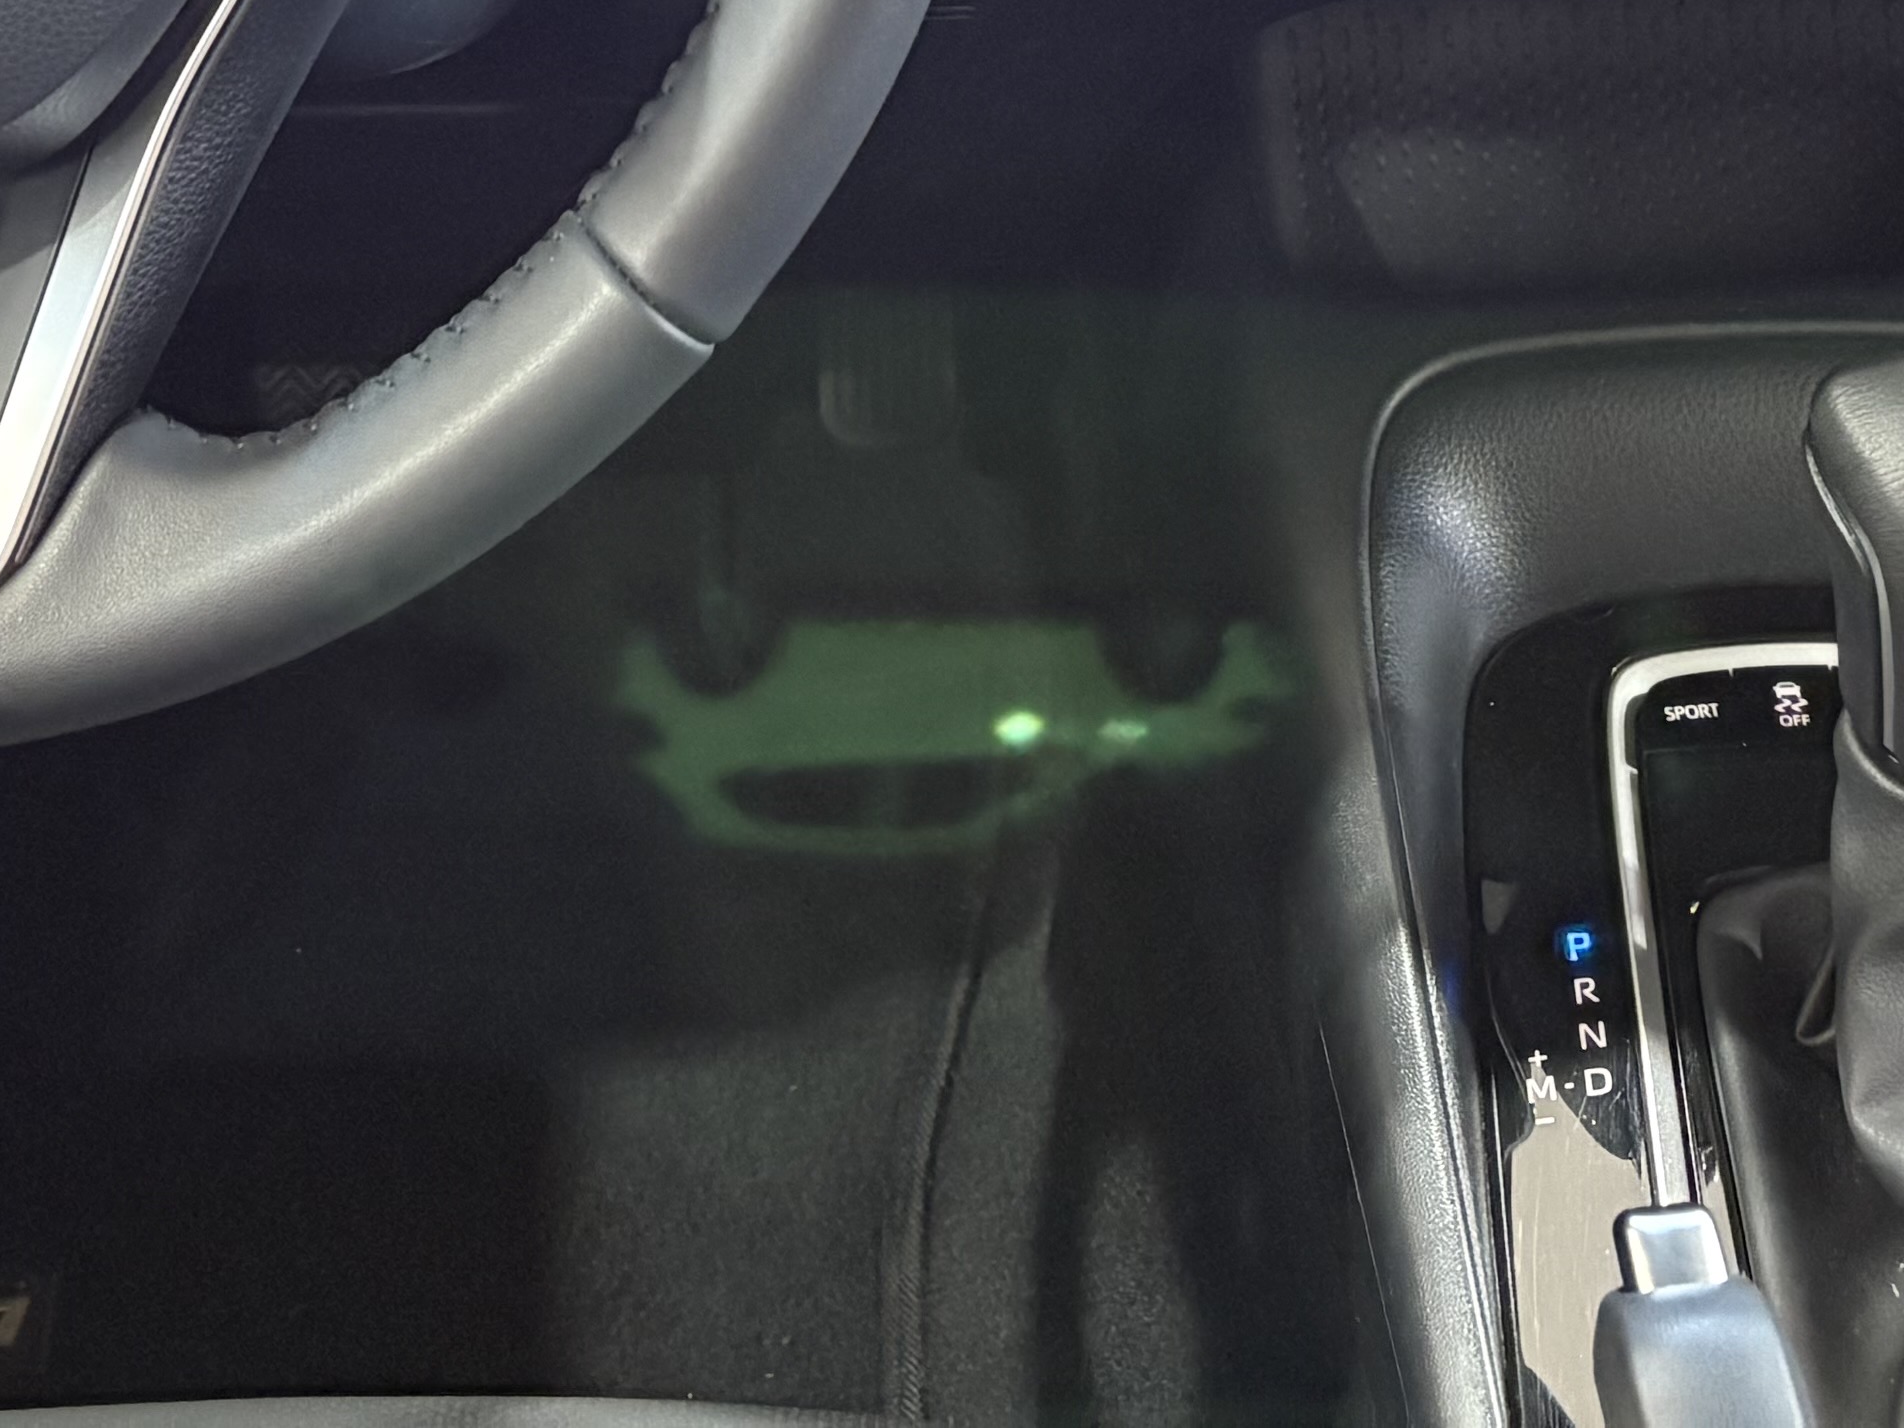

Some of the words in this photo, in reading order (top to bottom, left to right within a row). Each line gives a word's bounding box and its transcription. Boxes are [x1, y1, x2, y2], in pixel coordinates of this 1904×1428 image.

[1664, 701, 1720, 723] SPORT
[1779, 713, 1811, 729] OFF
[1565, 931, 1592, 962] P
[1574, 976, 1600, 1005] R
[1578, 1020, 1608, 1050] N
[1526, 1074, 1559, 1104] M
[1584, 1067, 1614, 1098] D
